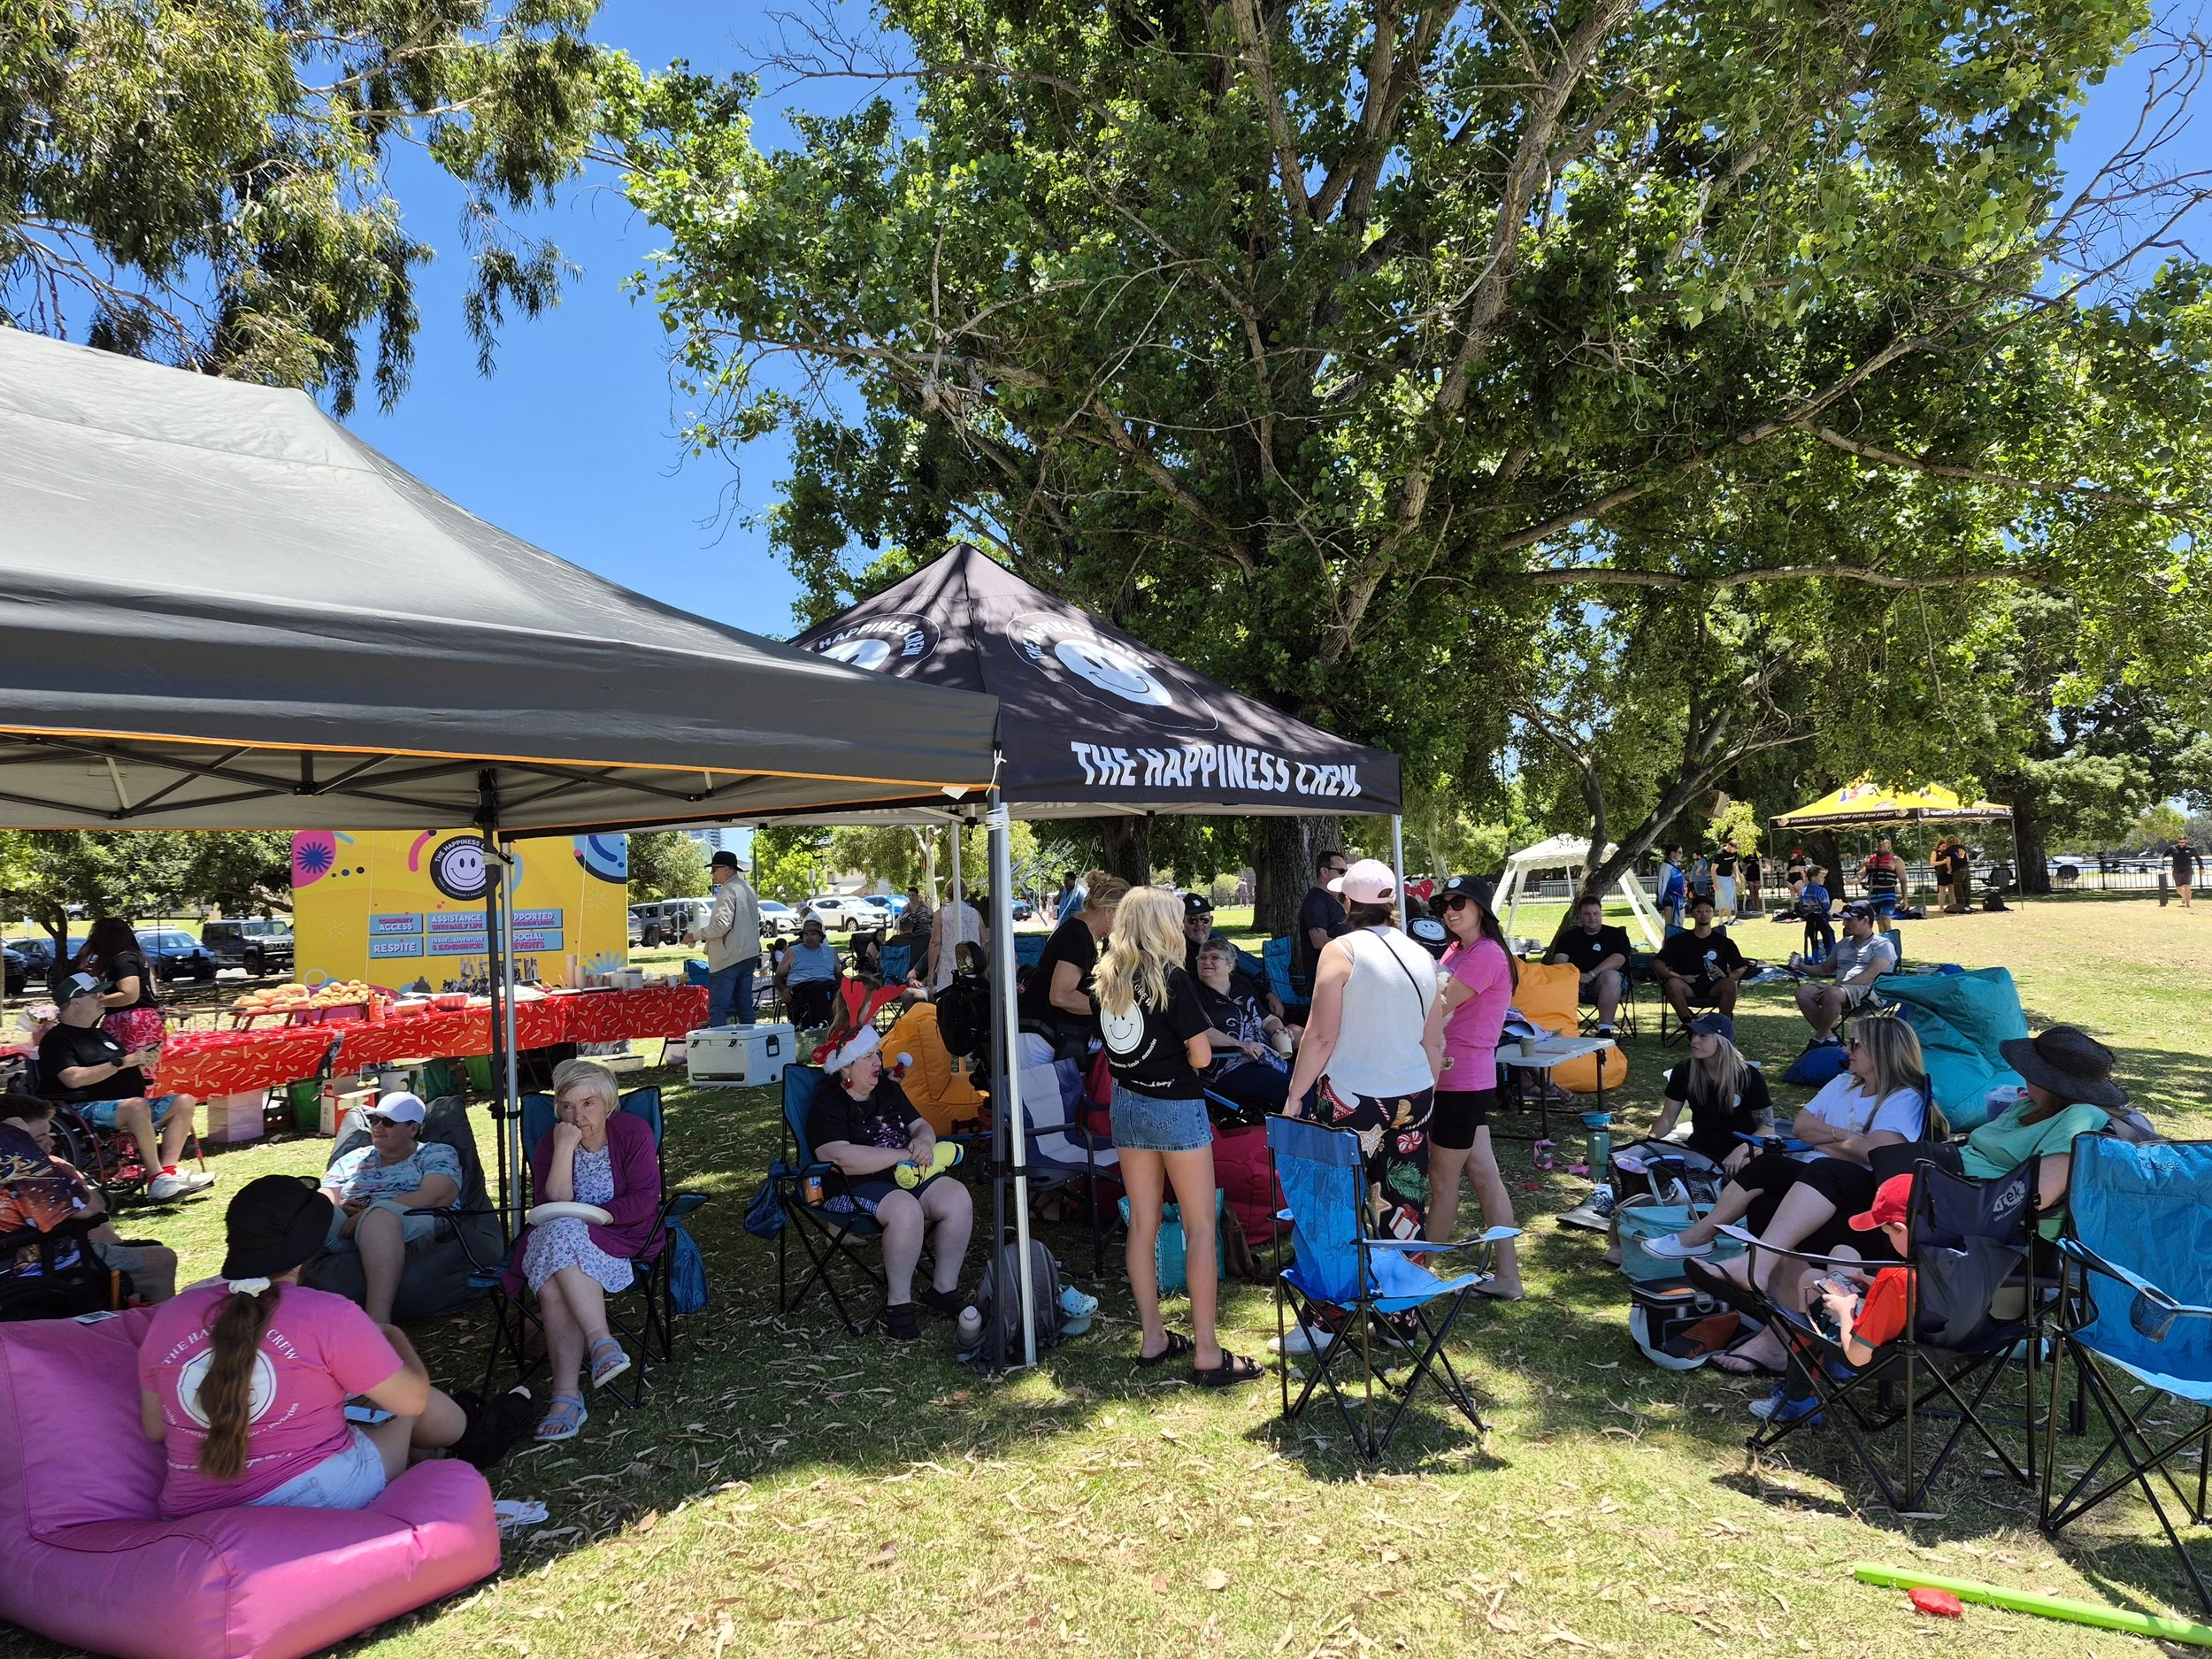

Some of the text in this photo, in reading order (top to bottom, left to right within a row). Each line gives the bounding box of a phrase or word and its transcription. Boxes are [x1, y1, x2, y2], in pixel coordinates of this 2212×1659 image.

[818, 621, 926, 657] HAPPINESS CREW
[1023, 621, 1156, 669] THE HAPPINESS CREW
[1071, 741, 1362, 797] THE HAPPINESS CREW
[434, 850, 446, 863] THE
[443, 839, 480, 851] HAPPINESS
[432, 914, 482, 923] ASSISTANCE
[513, 912, 555, 921] PPORTED
[374, 943, 416, 953] RESPITE
[512, 941, 545, 949] EVENTS
[162, 1329, 299, 1364] THE CREW
